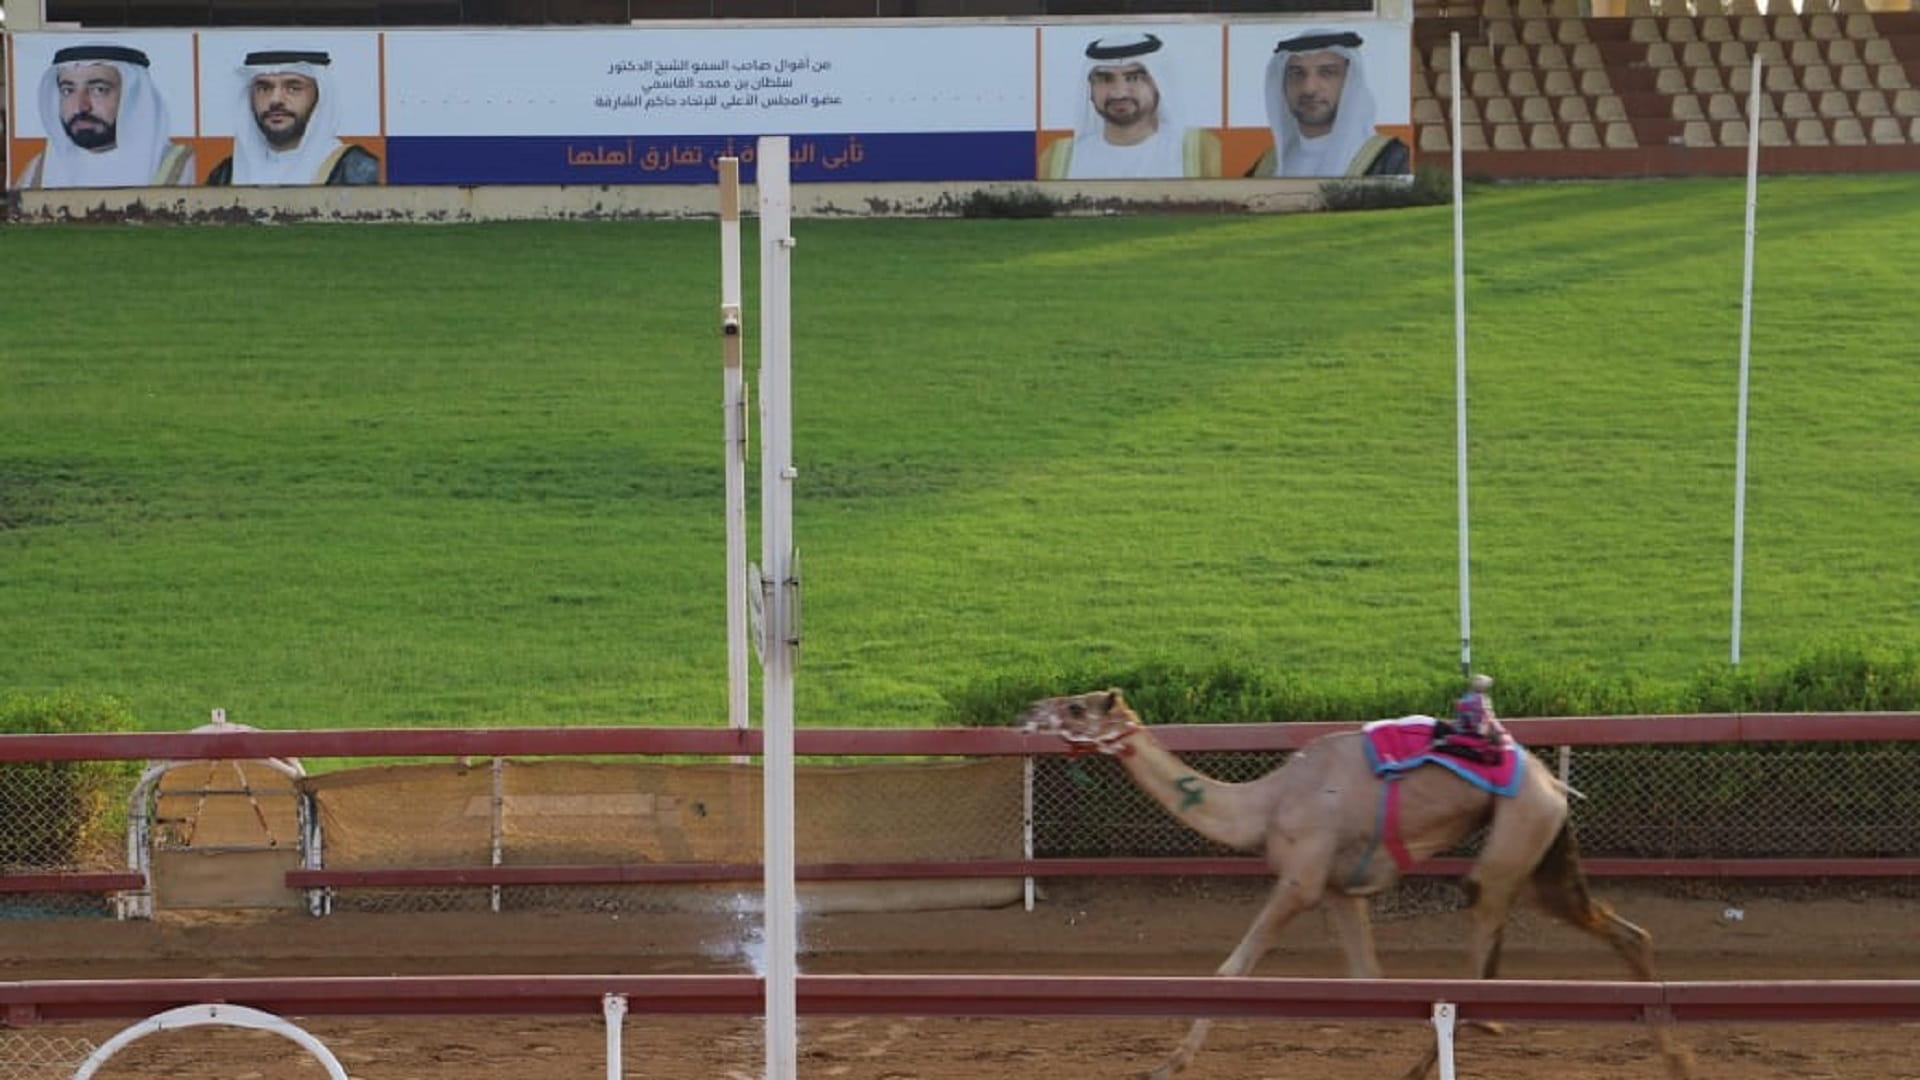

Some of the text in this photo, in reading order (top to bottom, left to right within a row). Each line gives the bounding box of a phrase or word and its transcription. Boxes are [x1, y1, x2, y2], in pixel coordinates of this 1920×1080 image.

[607, 54, 832, 77] من أقوال صاحب السمو الشيخ الدكتور
[641, 76, 793, 95] سلطان بن محمد القاسمي
[594, 94, 643, 111] الشارقة
[644, 95, 678, 111] حاكم
[760, 93, 808, 109] المجلس
[810, 93, 843, 109] عضو
[566, 138, 633, 166] أهلها
[640, 145, 703, 171] تفارق
